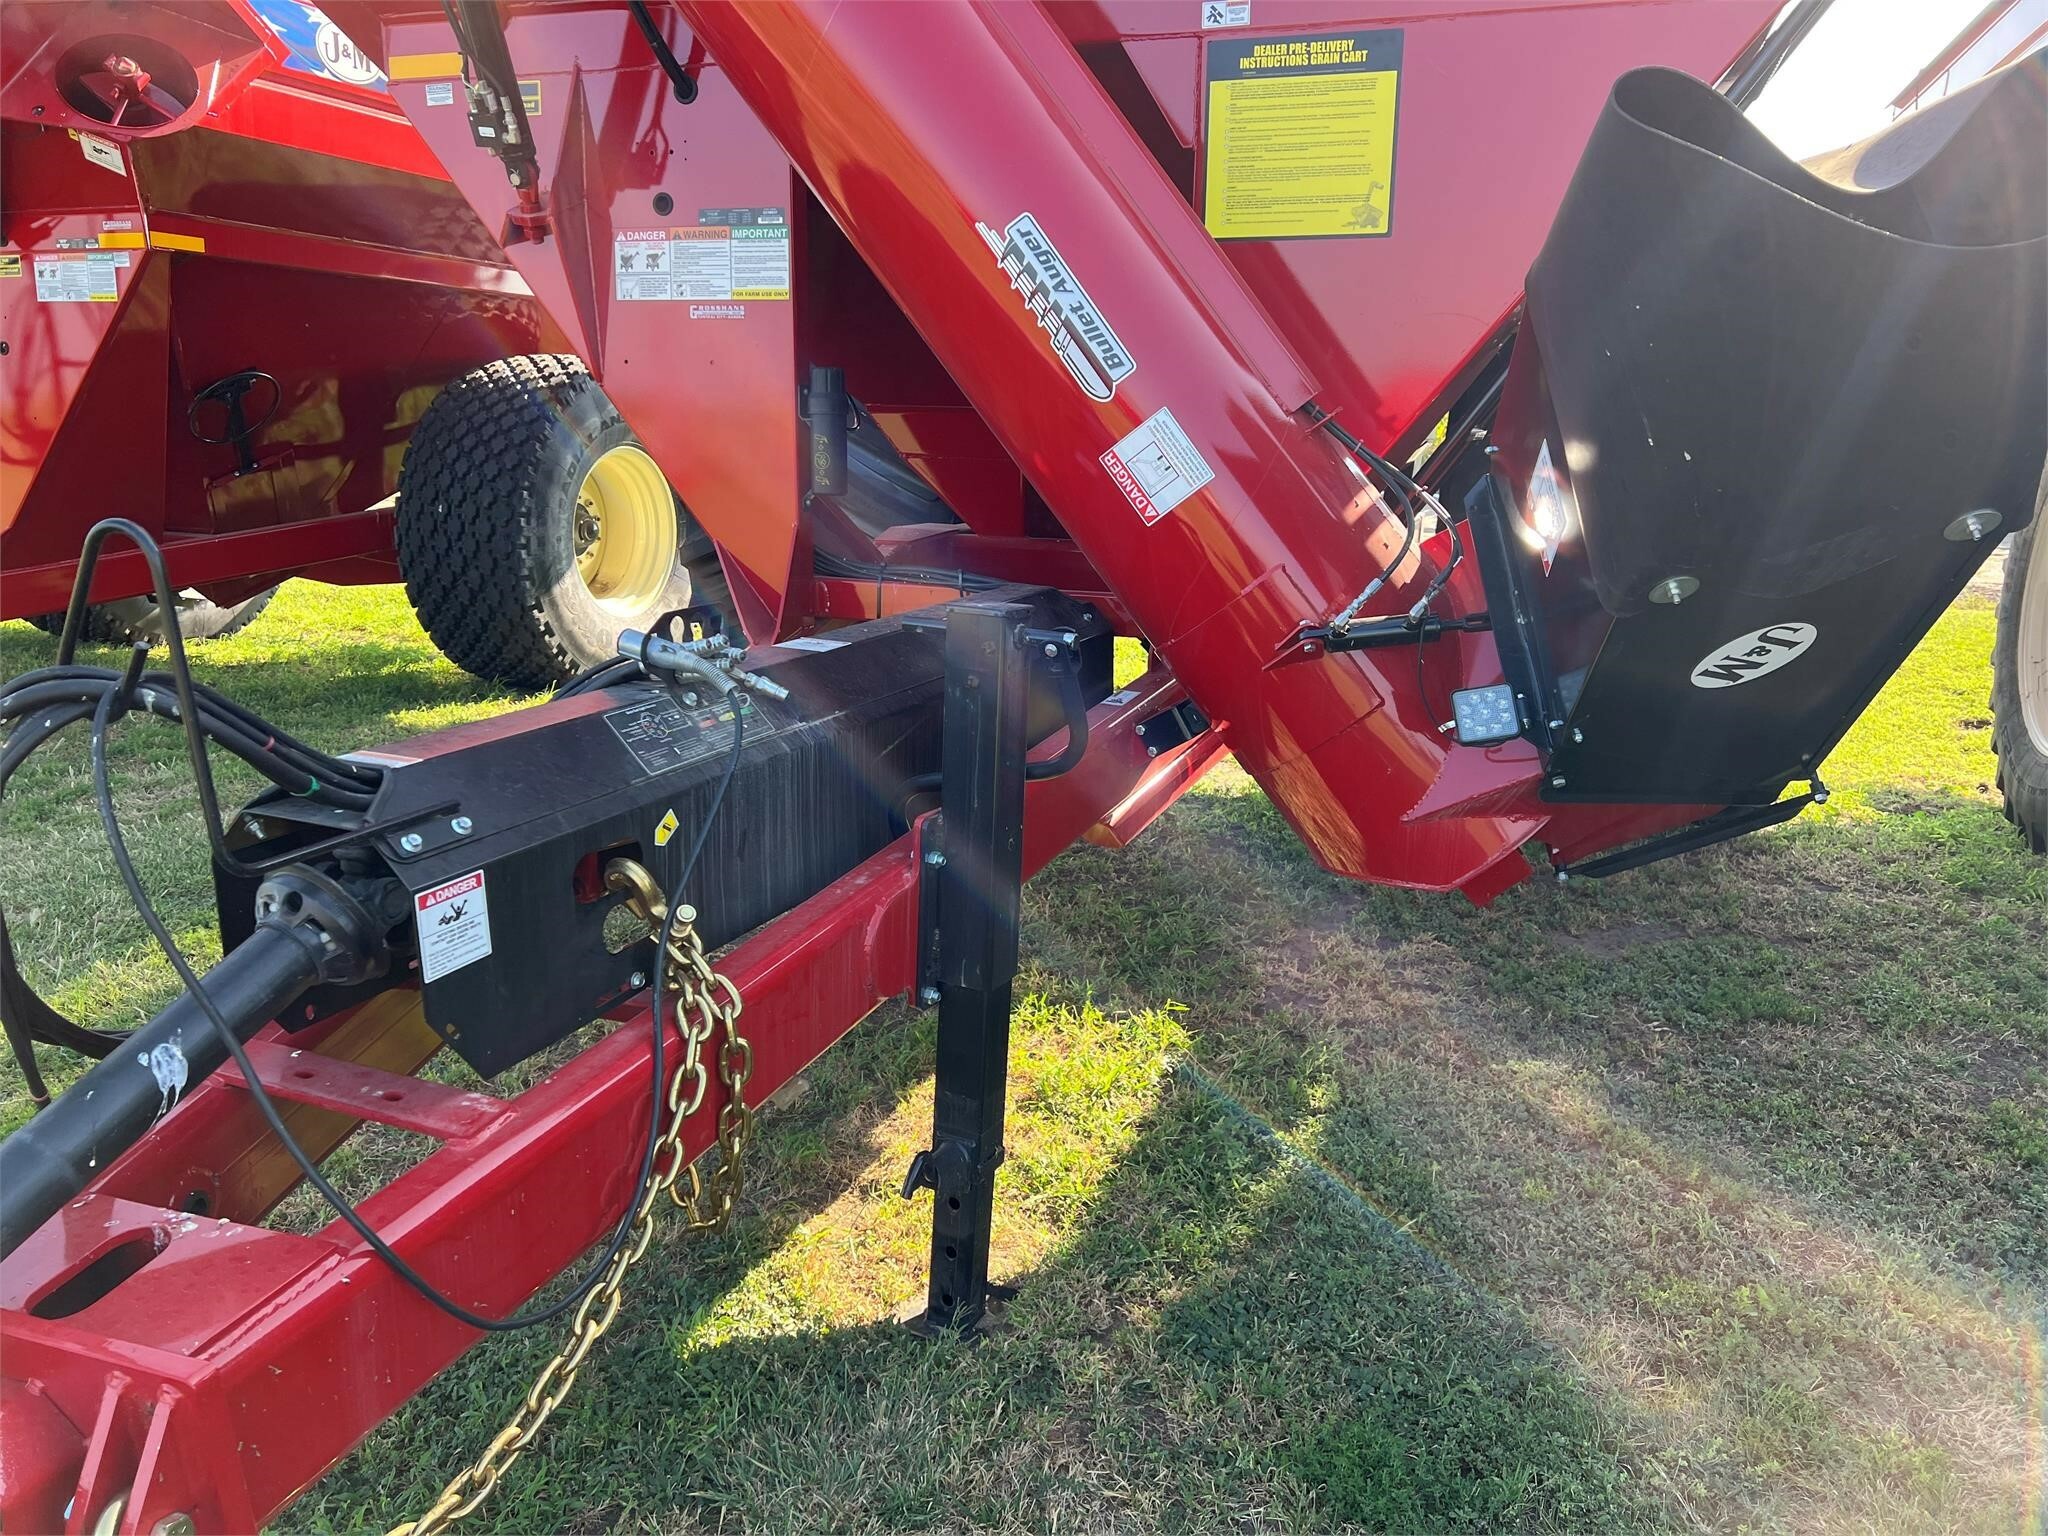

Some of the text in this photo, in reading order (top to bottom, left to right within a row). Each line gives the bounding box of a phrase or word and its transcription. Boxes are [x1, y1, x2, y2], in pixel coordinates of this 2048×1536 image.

[323, 29, 373, 74] J&M
[1253, 39, 1355, 57] DEALER PRE-DELIVERY
[1239, 50, 1369, 70] INSTRUCTIONS GRAIN CART
[627, 231, 666, 241] DANGER
[683, 229, 728, 239] WARNING
[731, 228, 788, 239] IMPORTANT
[1016, 228, 1126, 371] Bullet Auger
[1103, 452, 1149, 509] DANGER
[1695, 625, 1804, 684] J&M
[435, 877, 478, 902] DANGER
